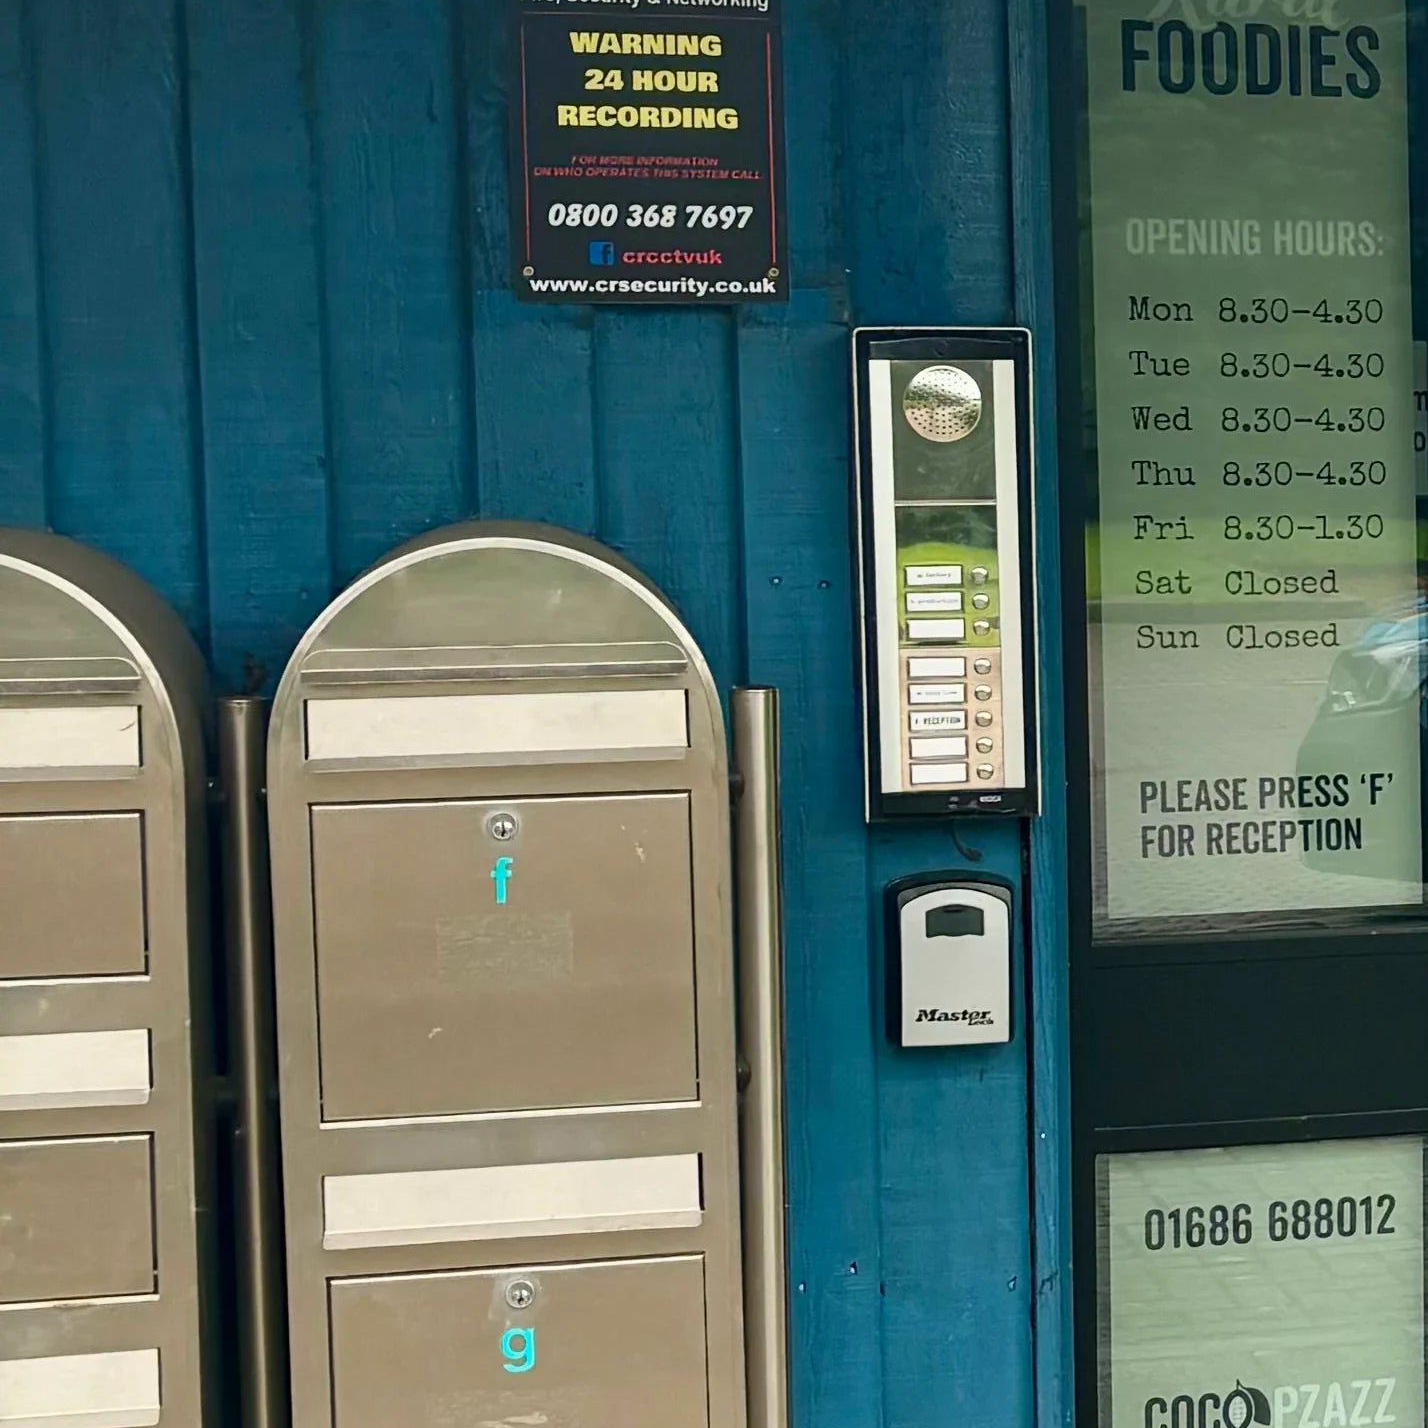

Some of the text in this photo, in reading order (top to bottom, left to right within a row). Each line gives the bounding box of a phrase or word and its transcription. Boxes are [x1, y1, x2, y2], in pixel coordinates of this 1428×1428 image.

[569, 31, 722, 57] WARNING
[1121, 18, 1382, 100] FOODIES
[584, 69, 718, 92] 24 HOUR
[557, 105, 739, 130] RECORDING
[586, 168, 649, 178] OPERATES
[681, 169, 729, 179] SYSTEM
[637, 156, 719, 167] INFORMATION
[548, 203, 753, 230] 0800 368 7697
[1125, 217, 1385, 258] OPENING HOURS:
[622, 249, 723, 265] crcctvuk
[529, 277, 777, 298] www.crsecurity.co.uk
[1128, 296, 1194, 323] Mon
[1129, 350, 1192, 377] Tue
[1131, 404, 1194, 432] Wed
[1132, 459, 1197, 487] Thu
[1133, 514, 1195, 541] Fri
[1135, 568, 1340, 596] Sat Closed
[1136, 622, 1341, 651] Sun Closed
[1139, 778, 1248, 814] PLEASE
[1258, 775, 1350, 810] PRESS
[1141, 818, 1362, 859] FOR RECEPTION
[490, 857, 514, 904] f
[916, 1008, 991, 1022] Master
[1145, 1193, 1396, 1251] 01686 688012
[498, 1324, 537, 1373] g
